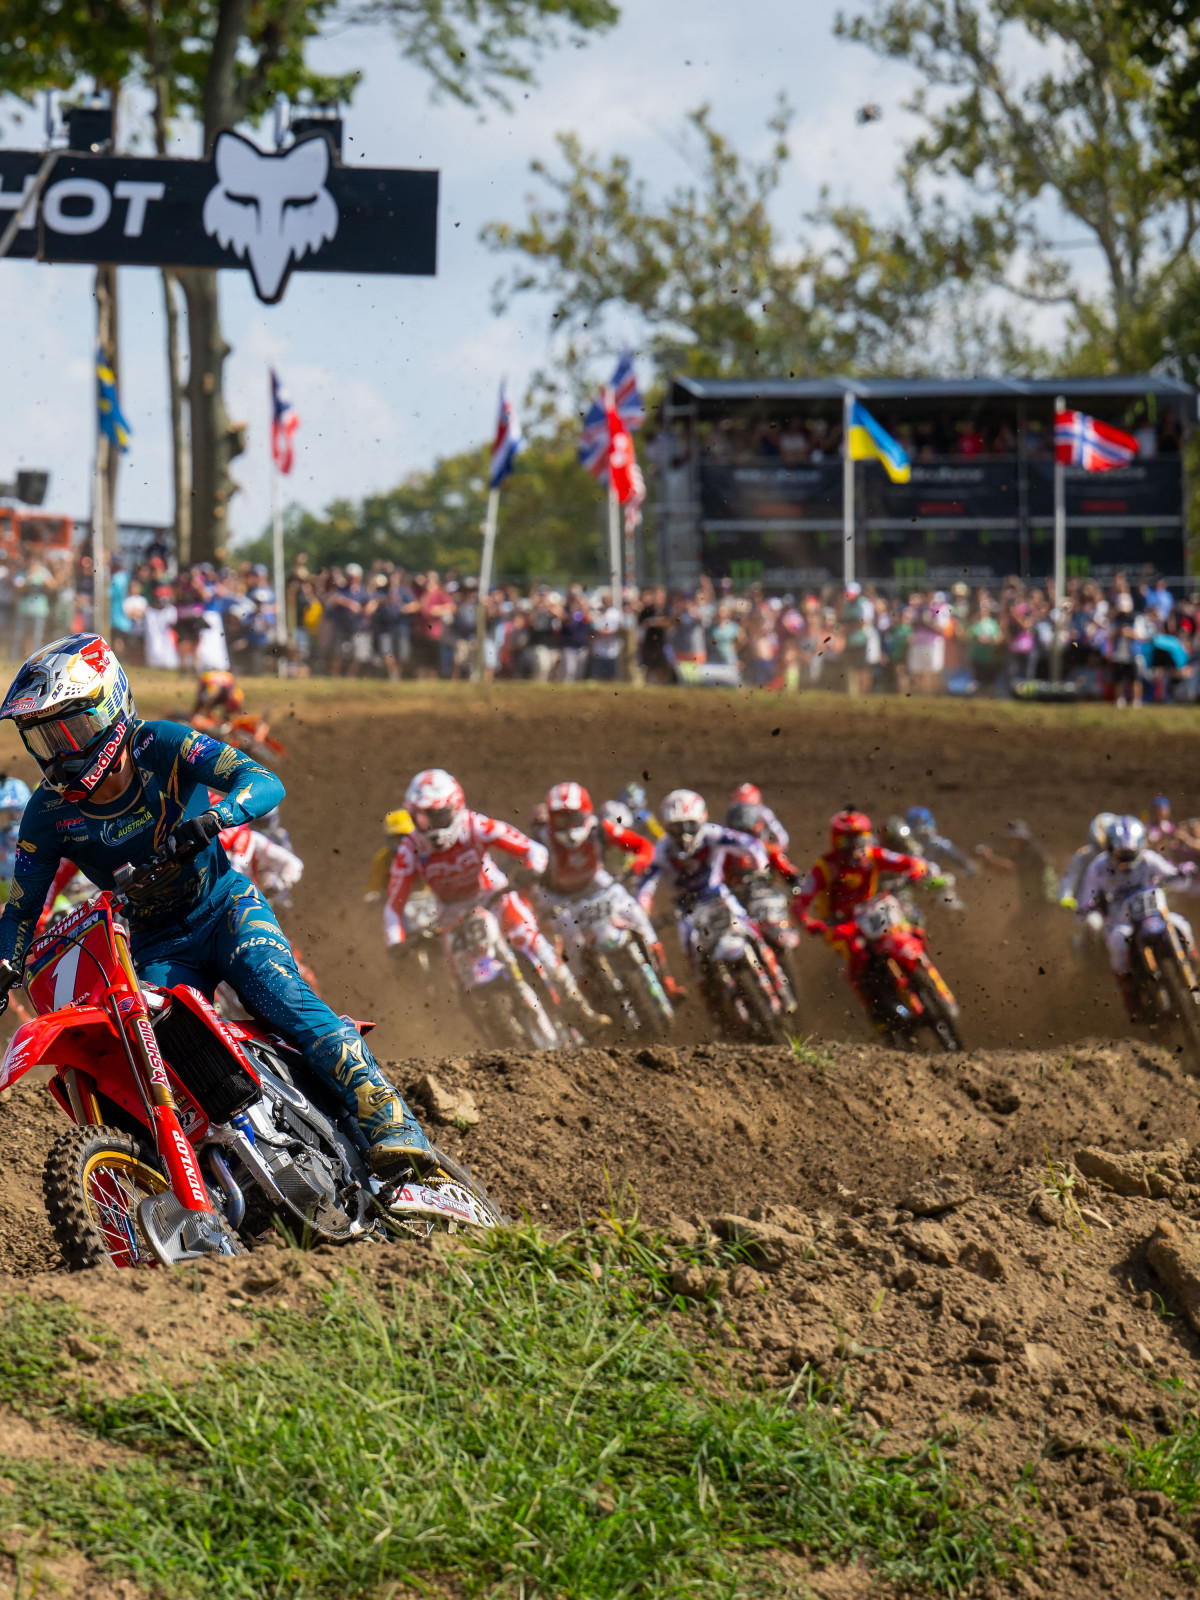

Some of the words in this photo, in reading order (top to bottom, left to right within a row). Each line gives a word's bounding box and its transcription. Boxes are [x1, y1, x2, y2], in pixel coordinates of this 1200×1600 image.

[80, 749, 110, 791] Red
[103, 721, 128, 760] Bull
[117, 811, 153, 838] AUSTRALIA
[50, 935, 89, 1013] 1
[137, 1018, 164, 1072] SHOWA
[172, 1129, 206, 1204] DUNLOP
